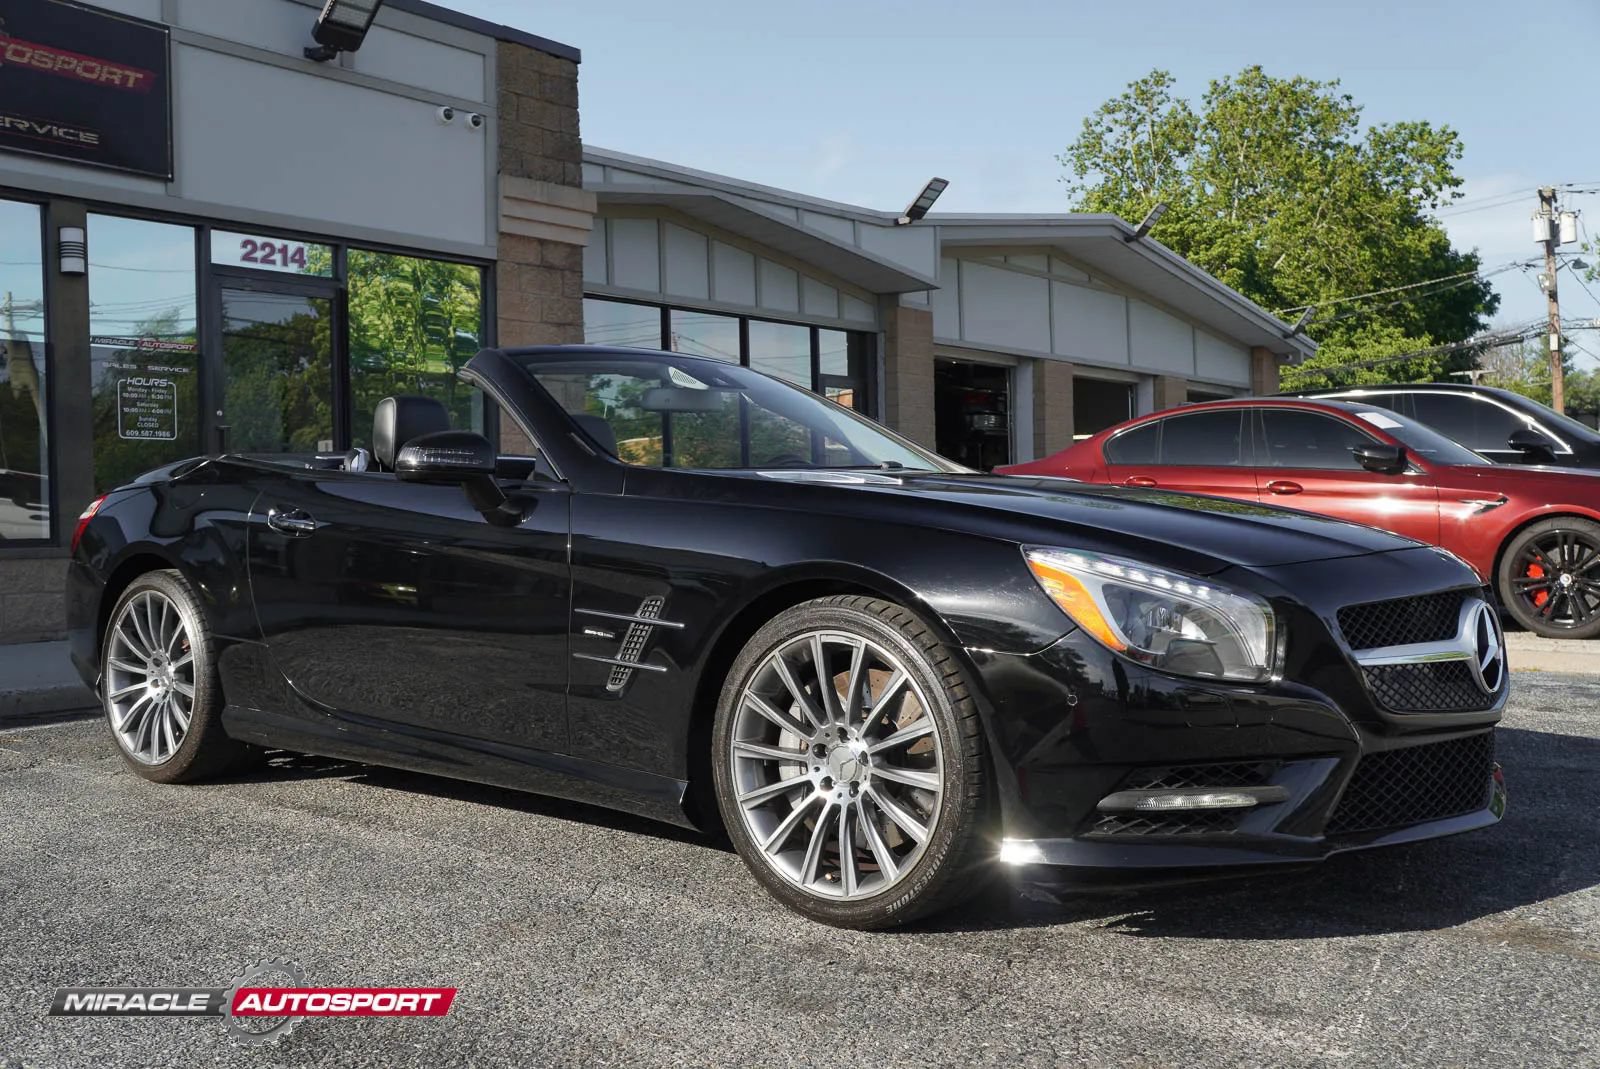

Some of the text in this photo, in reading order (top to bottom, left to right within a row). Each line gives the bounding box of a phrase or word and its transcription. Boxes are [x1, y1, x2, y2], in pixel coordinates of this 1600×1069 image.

[0, 115, 99, 144] RVICE
[240, 239, 306, 268] 2214
[94, 337, 195, 351] MIRACLE AUTOSPORT
[102, 362, 189, 373] SALES SERVICE
[126, 377, 168, 387] HOURS
